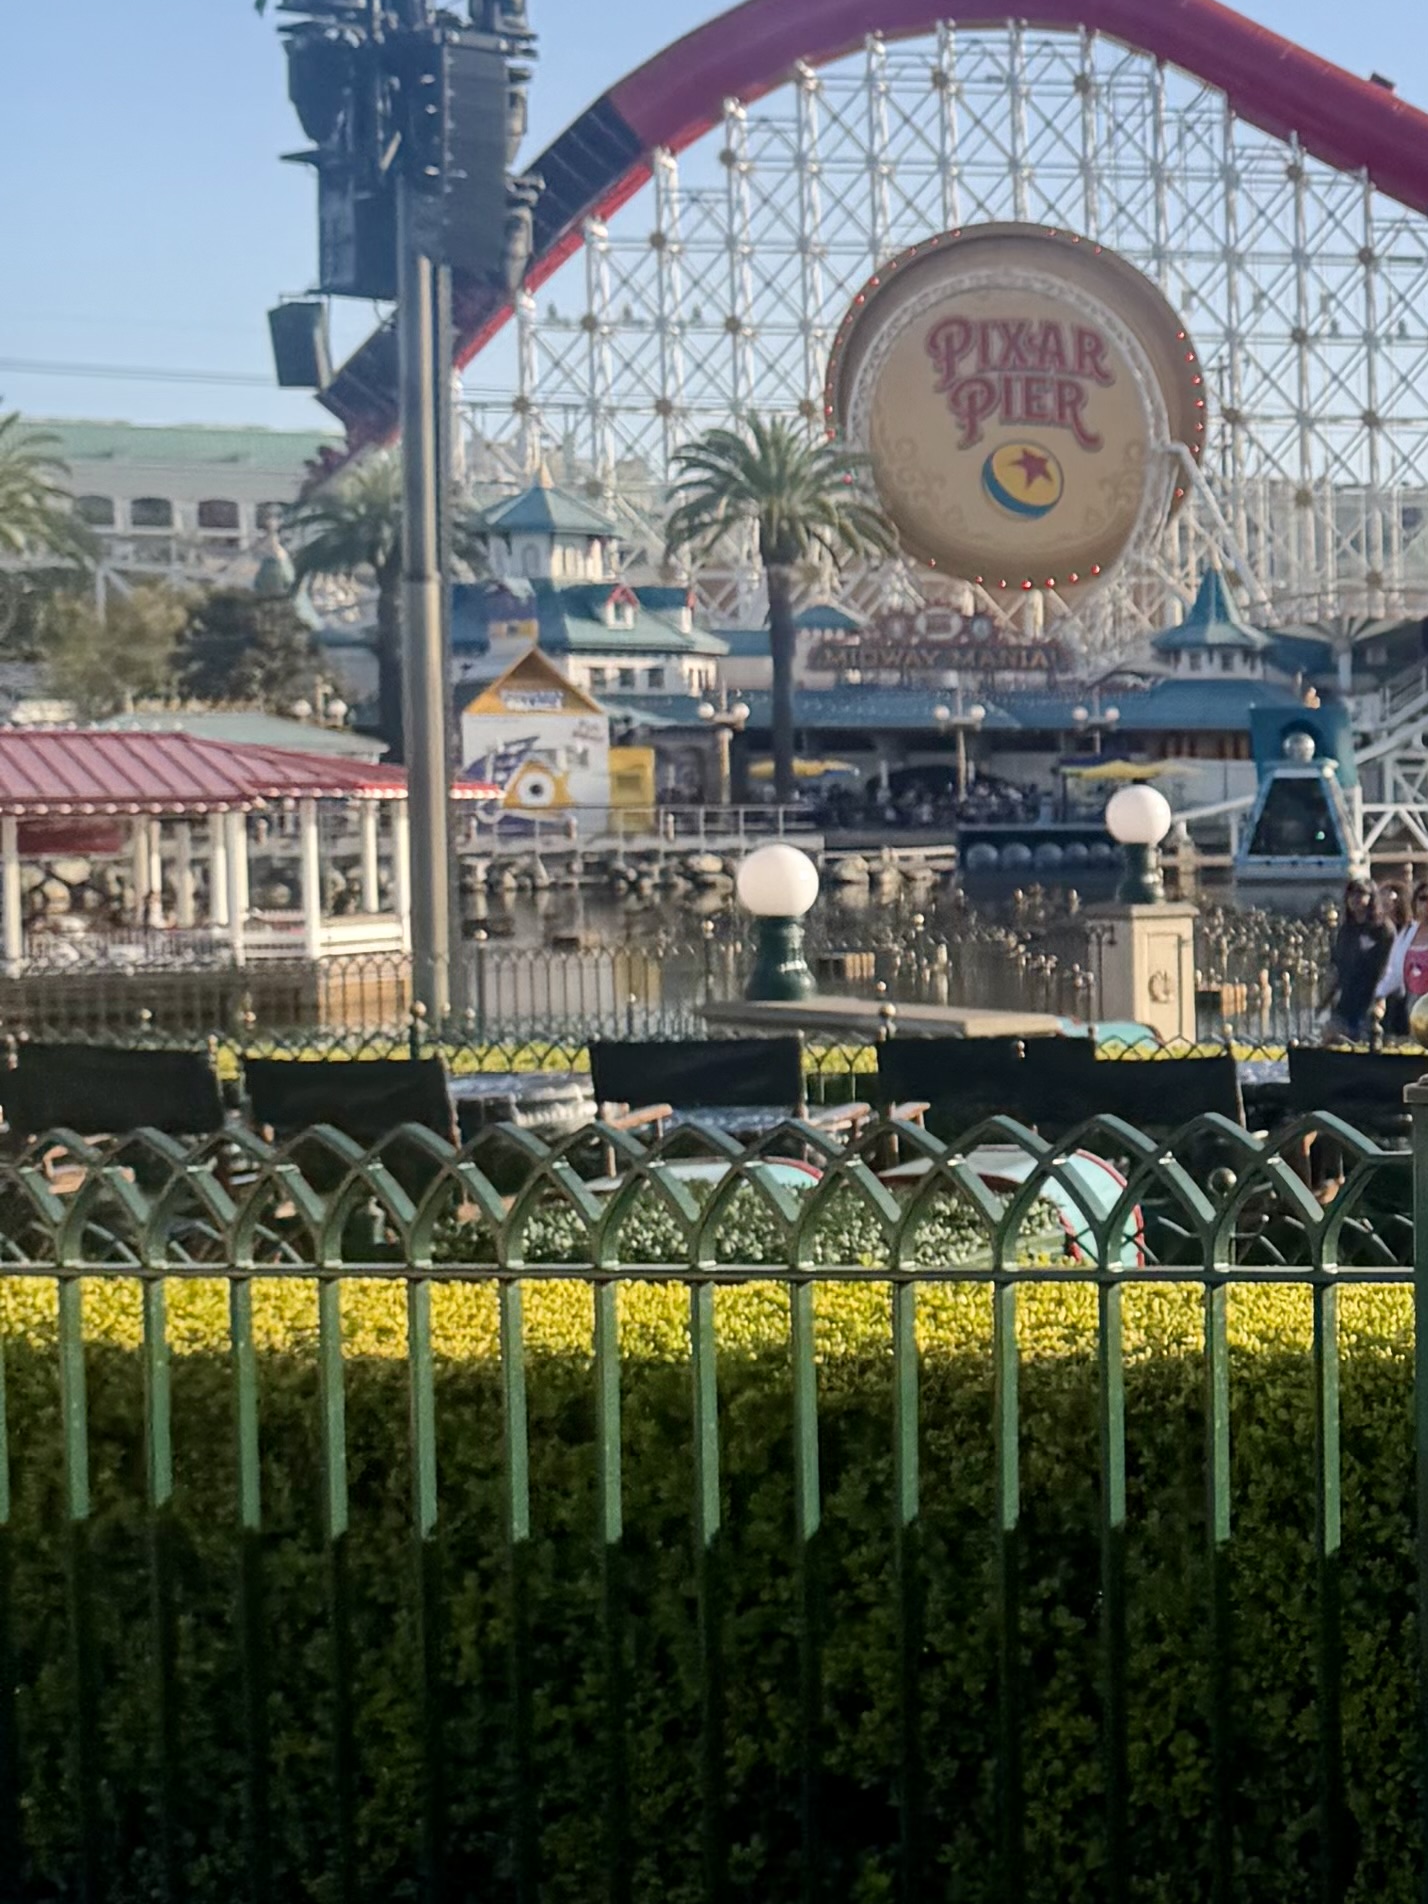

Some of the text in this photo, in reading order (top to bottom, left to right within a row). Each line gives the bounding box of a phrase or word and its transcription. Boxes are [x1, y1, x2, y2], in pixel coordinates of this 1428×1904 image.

[927, 315, 1115, 393] PIXAR
[948, 374, 1104, 452] PIER
[823, 648, 940, 668] MIDWAY
